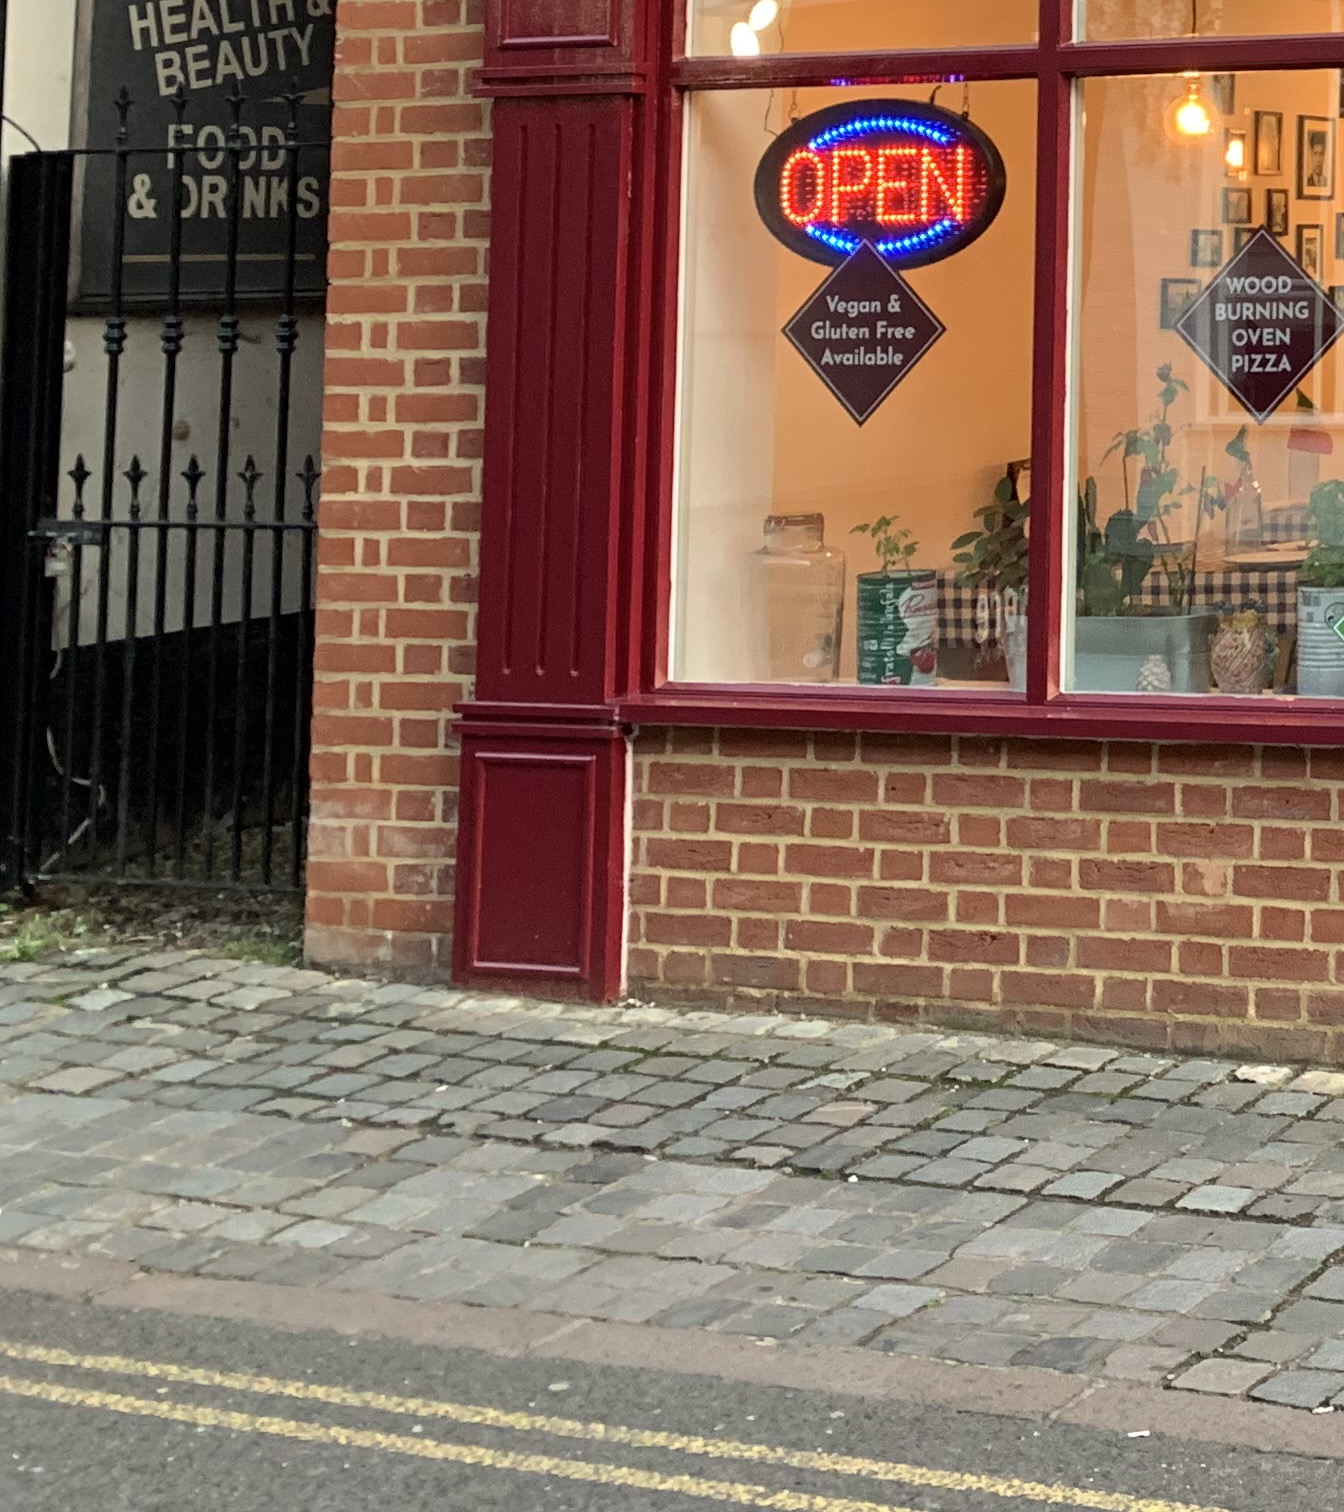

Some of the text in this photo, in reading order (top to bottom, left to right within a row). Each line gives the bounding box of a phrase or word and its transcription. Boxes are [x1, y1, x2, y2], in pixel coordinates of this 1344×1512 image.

[155, 23, 314, 97] BEAUTY
[780, 145, 966, 226] OPEN
[128, 173, 321, 219] & DRNKS
[1226, 276, 1292, 294] WOOD
[826, 294, 901, 318] Vegan &
[1215, 301, 1309, 321] BURNING
[811, 320, 916, 339] Gluten Free
[1231, 328, 1290, 346] OVEN
[821, 346, 903, 366] Available
[1231, 354, 1292, 373] PIZZA
